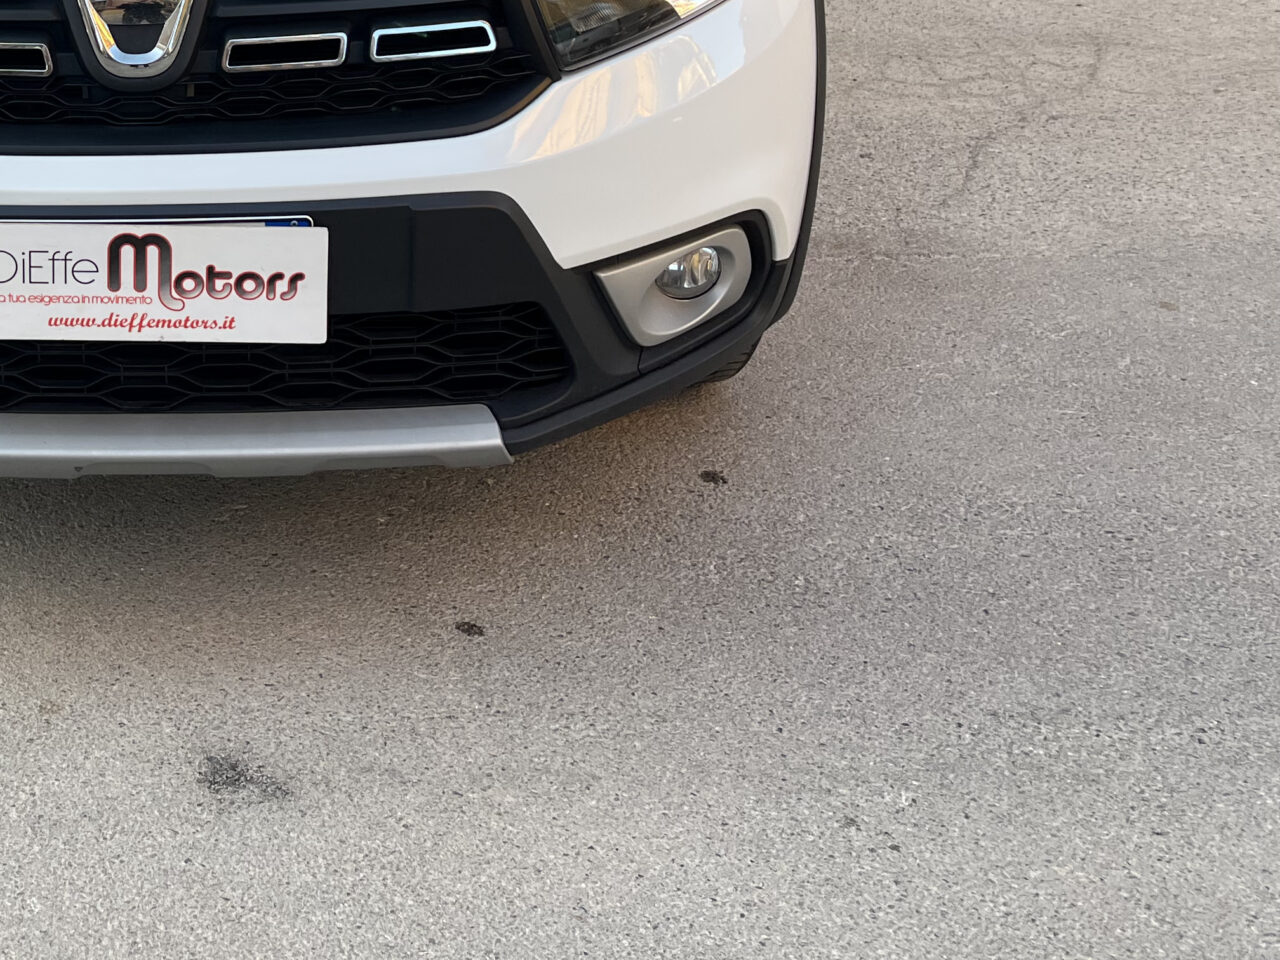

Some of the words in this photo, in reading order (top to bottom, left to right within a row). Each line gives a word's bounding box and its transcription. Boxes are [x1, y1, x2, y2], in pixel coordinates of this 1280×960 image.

[107, 233, 306, 312] Motors
[8, 293, 26, 304] tua
[28, 294, 81, 307] esigenza
[81, 294, 90, 304] in
[91, 294, 153, 306] movimento
[48, 312, 236, 333] www.dieffemotors.it
